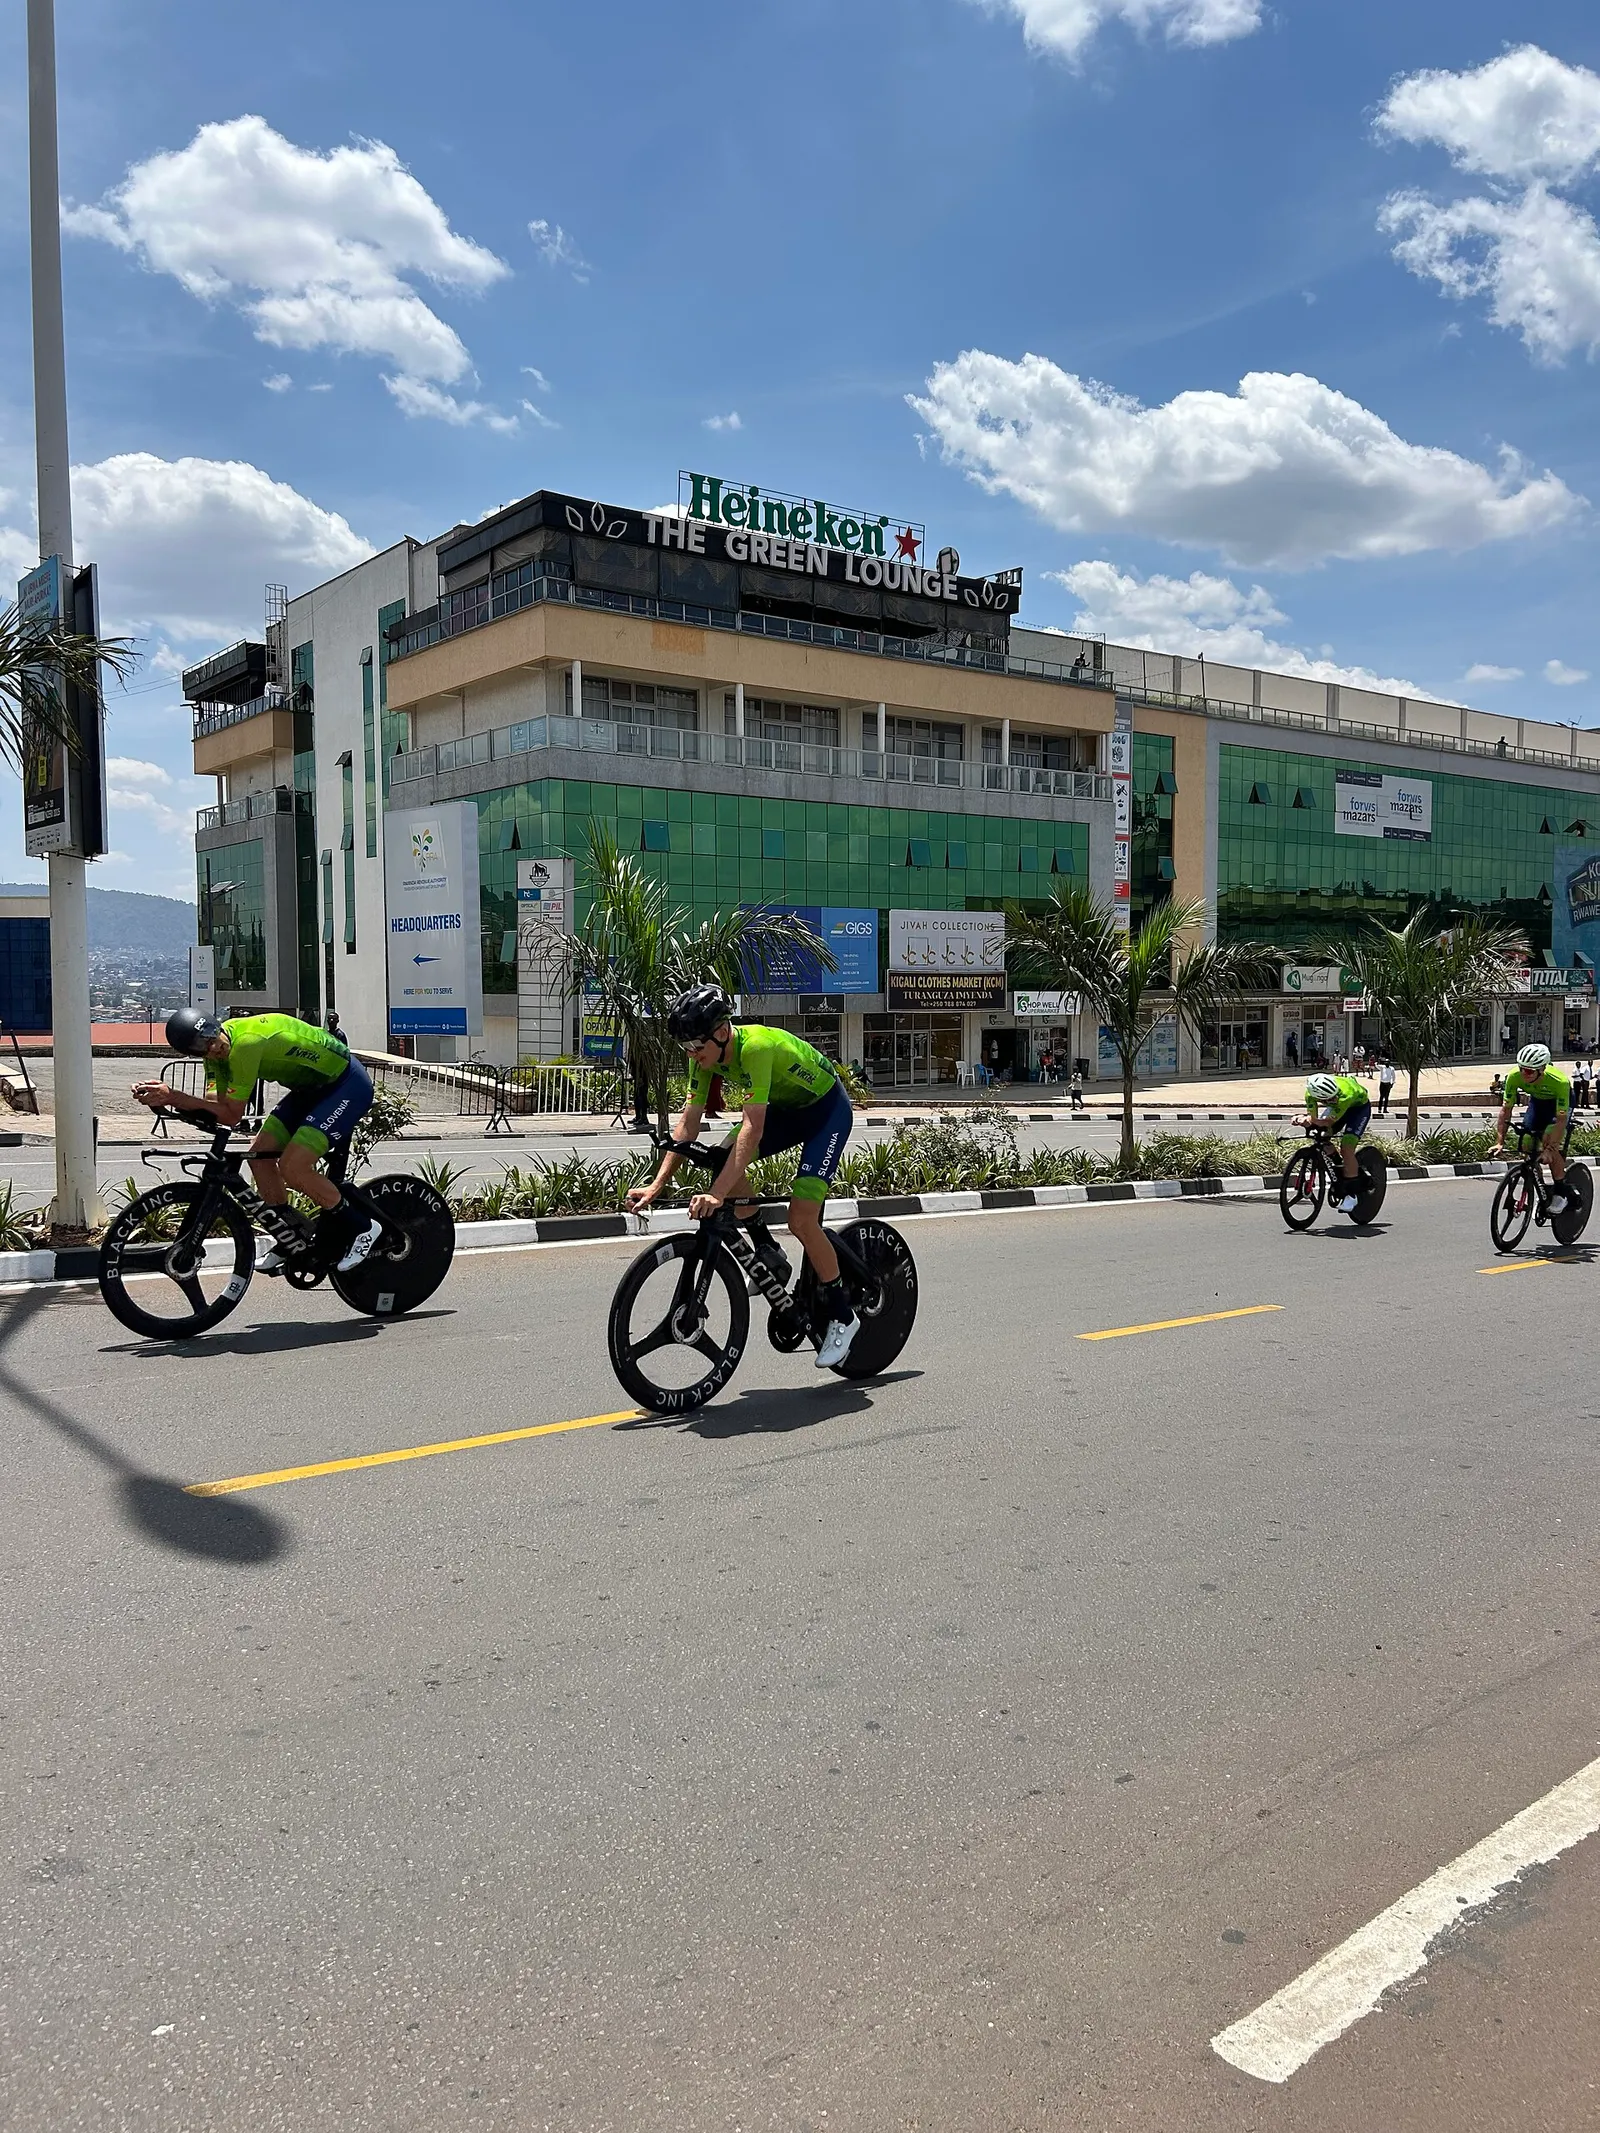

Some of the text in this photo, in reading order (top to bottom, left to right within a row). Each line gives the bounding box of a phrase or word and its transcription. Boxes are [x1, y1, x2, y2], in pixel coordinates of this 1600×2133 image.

[690, 473, 887, 557] Heineken
[642, 513, 958, 600] THE GREEN LOUNGE
[1350, 797, 1376, 812] forvis
[1398, 789, 1422, 803] forvis
[1343, 811, 1376, 822] mazars
[1390, 802, 1423, 814] mazars
[391, 914, 461, 932] HEADQUARTERS
[845, 922, 872, 934] GIGS
[900, 921, 928, 930] JIVAH
[890, 975, 1004, 990] KIGALI CLOTHES MARKET (KCM)
[1533, 970, 1569, 986] TOTAL
[903, 991, 993, 1000] TURANGUZA IMYENDA
[1042, 1001, 1059, 1009] WELL
[320, 1099, 350, 1131] SLOVENIA
[817, 1132, 839, 1177] SLOVENIA
[370, 1182, 442, 1212] LACK INC
[236, 1187, 307, 1255] FACTOR
[107, 1190, 174, 1279] BLACK INC
[859, 1226, 914, 1290] BLACK INC
[730, 1238, 794, 1313] FACTOR
[656, 1346, 739, 1407] BLACK INC
